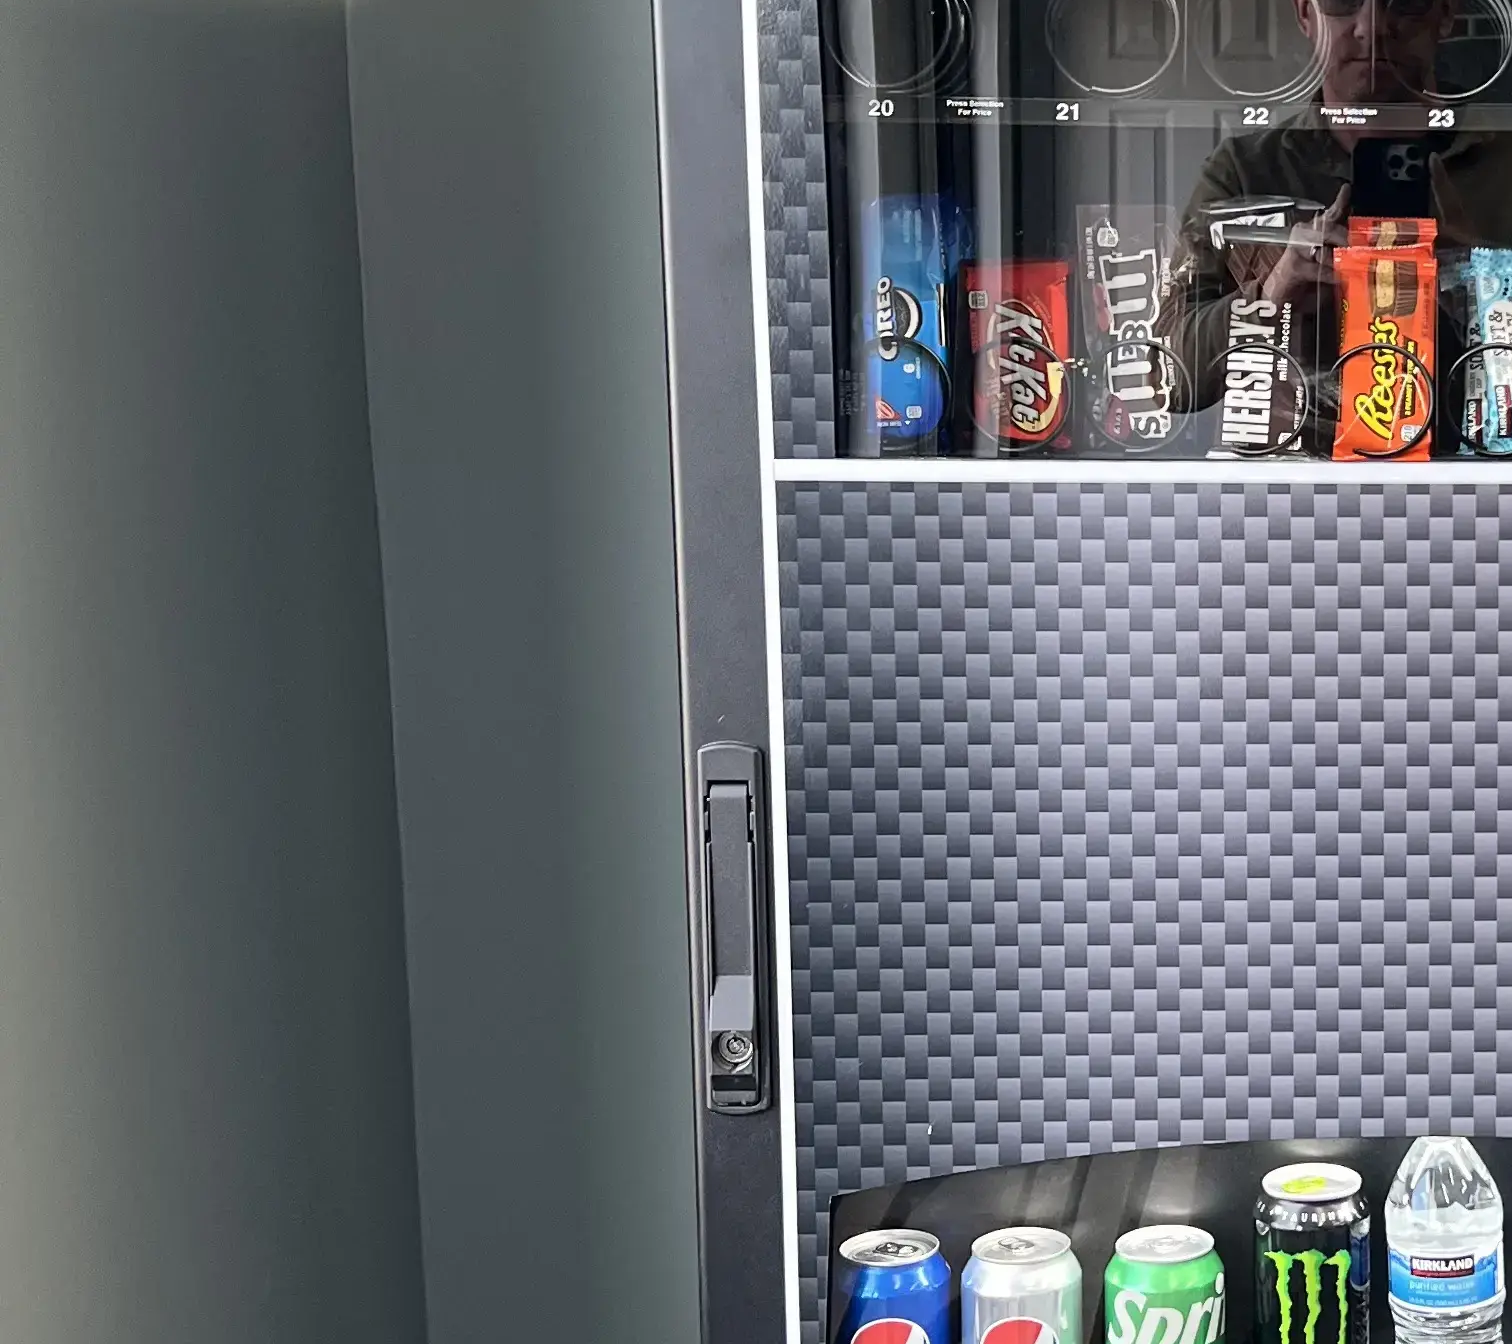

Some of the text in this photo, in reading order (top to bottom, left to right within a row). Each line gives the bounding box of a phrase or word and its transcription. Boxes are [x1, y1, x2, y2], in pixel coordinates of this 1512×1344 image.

[868, 99, 894, 117] 20
[946, 99, 968, 108] Press
[957, 108, 992, 117] For Price
[1055, 102, 1080, 121] 21
[1242, 107, 1269, 125] 22
[1331, 116, 1367, 125] For Price
[1428, 109, 1455, 128] 23
[876, 276, 898, 361] OREO
[1277, 302, 1292, 381] milk hocolate
[1489, 309, 1510, 357] SFT &
[1495, 386, 1508, 437] KIRKLAND
[1412, 1257, 1473, 1272] KIRKLAND
